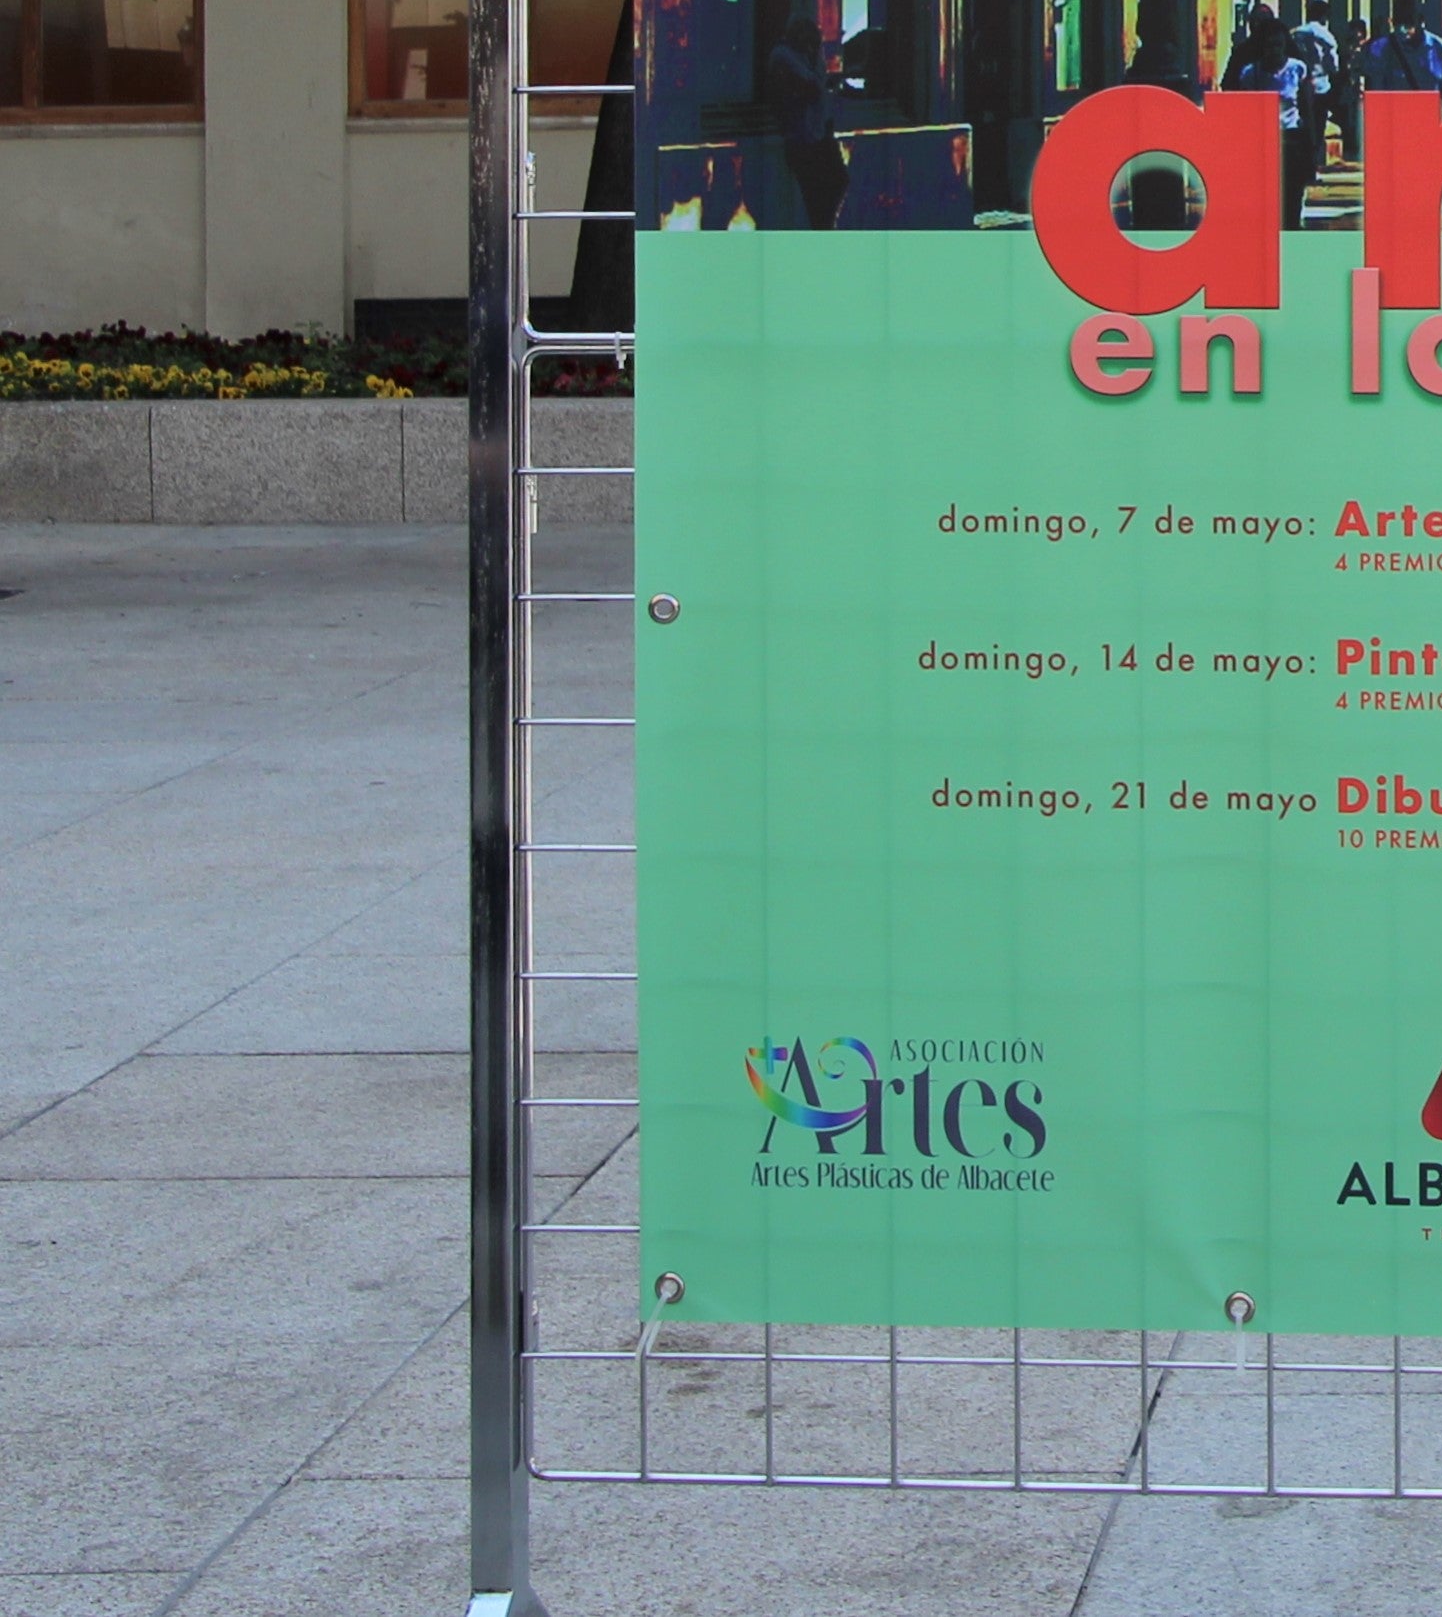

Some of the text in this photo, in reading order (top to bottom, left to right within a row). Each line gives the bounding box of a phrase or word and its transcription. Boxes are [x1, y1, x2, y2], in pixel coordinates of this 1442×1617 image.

[1070, 313, 1261, 396] en
[938, 502, 1099, 543] domingo,
[1117, 505, 1138, 534] 7
[1154, 503, 1195, 535] de
[1212, 515, 1315, 544] mayo:
[1334, 552, 1348, 572] 4
[918, 639, 1079, 680] domingo,
[1101, 643, 1139, 672] 14
[1155, 641, 1195, 673] de
[1213, 653, 1316, 682] mayo:
[1335, 691, 1349, 710] 4
[931, 777, 1092, 818] domingo,
[1111, 781, 1146, 810] 21
[1169, 779, 1209, 811] de
[1227, 791, 1317, 821] mayo
[1338, 828, 1364, 849] 10
[890, 1039, 1044, 1064] ASOCIACIÓN
[758, 1035, 1047, 1159] Artes
[751, 1161, 1055, 1192] Artes Plásticas de Albacete
